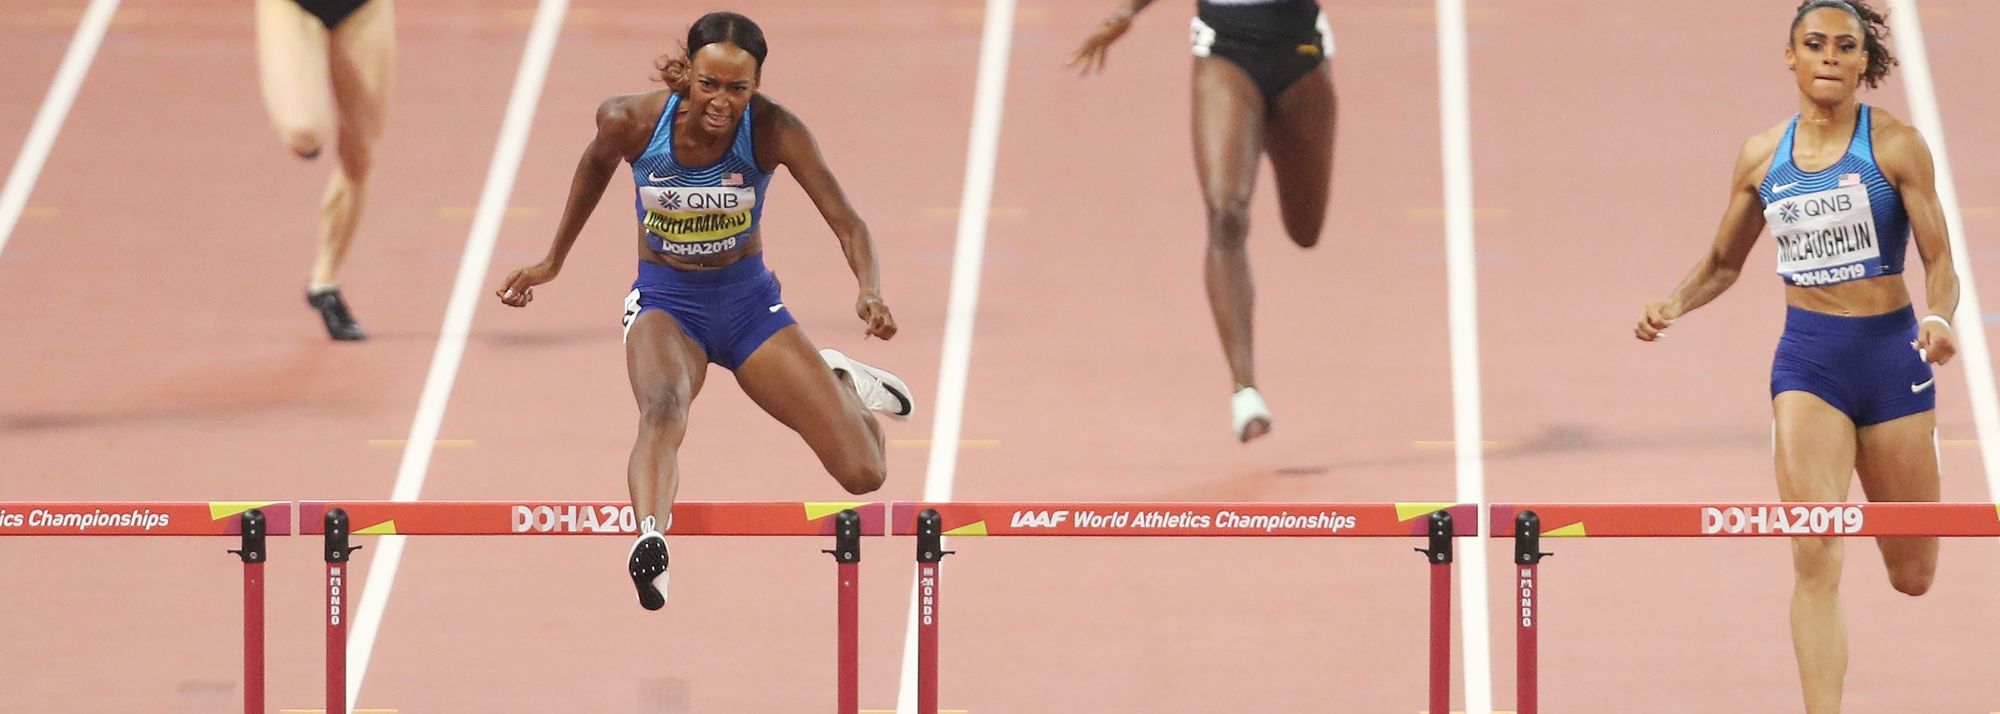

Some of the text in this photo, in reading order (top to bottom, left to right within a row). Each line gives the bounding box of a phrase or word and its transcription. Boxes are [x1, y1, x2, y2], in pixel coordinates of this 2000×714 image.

[687, 193, 739, 209] QNB
[1804, 194, 1852, 217] QNB
[648, 211, 746, 234] MUHAMMAD
[662, 236, 736, 255] DOHA2019
[1777, 221, 1872, 263] McLAUGHLIN
[1792, 263, 1866, 286] DOHA2019
[28, 509, 170, 530] Championships
[511, 505, 673, 533] DOHA20
[1010, 510, 1356, 532] IAAF World Athletics Championships
[1701, 506, 1864, 534] DOHA2019
[330, 577, 341, 625] MONDO
[923, 577, 934, 625] MONDO
[1520, 579, 1532, 627] MONDO
